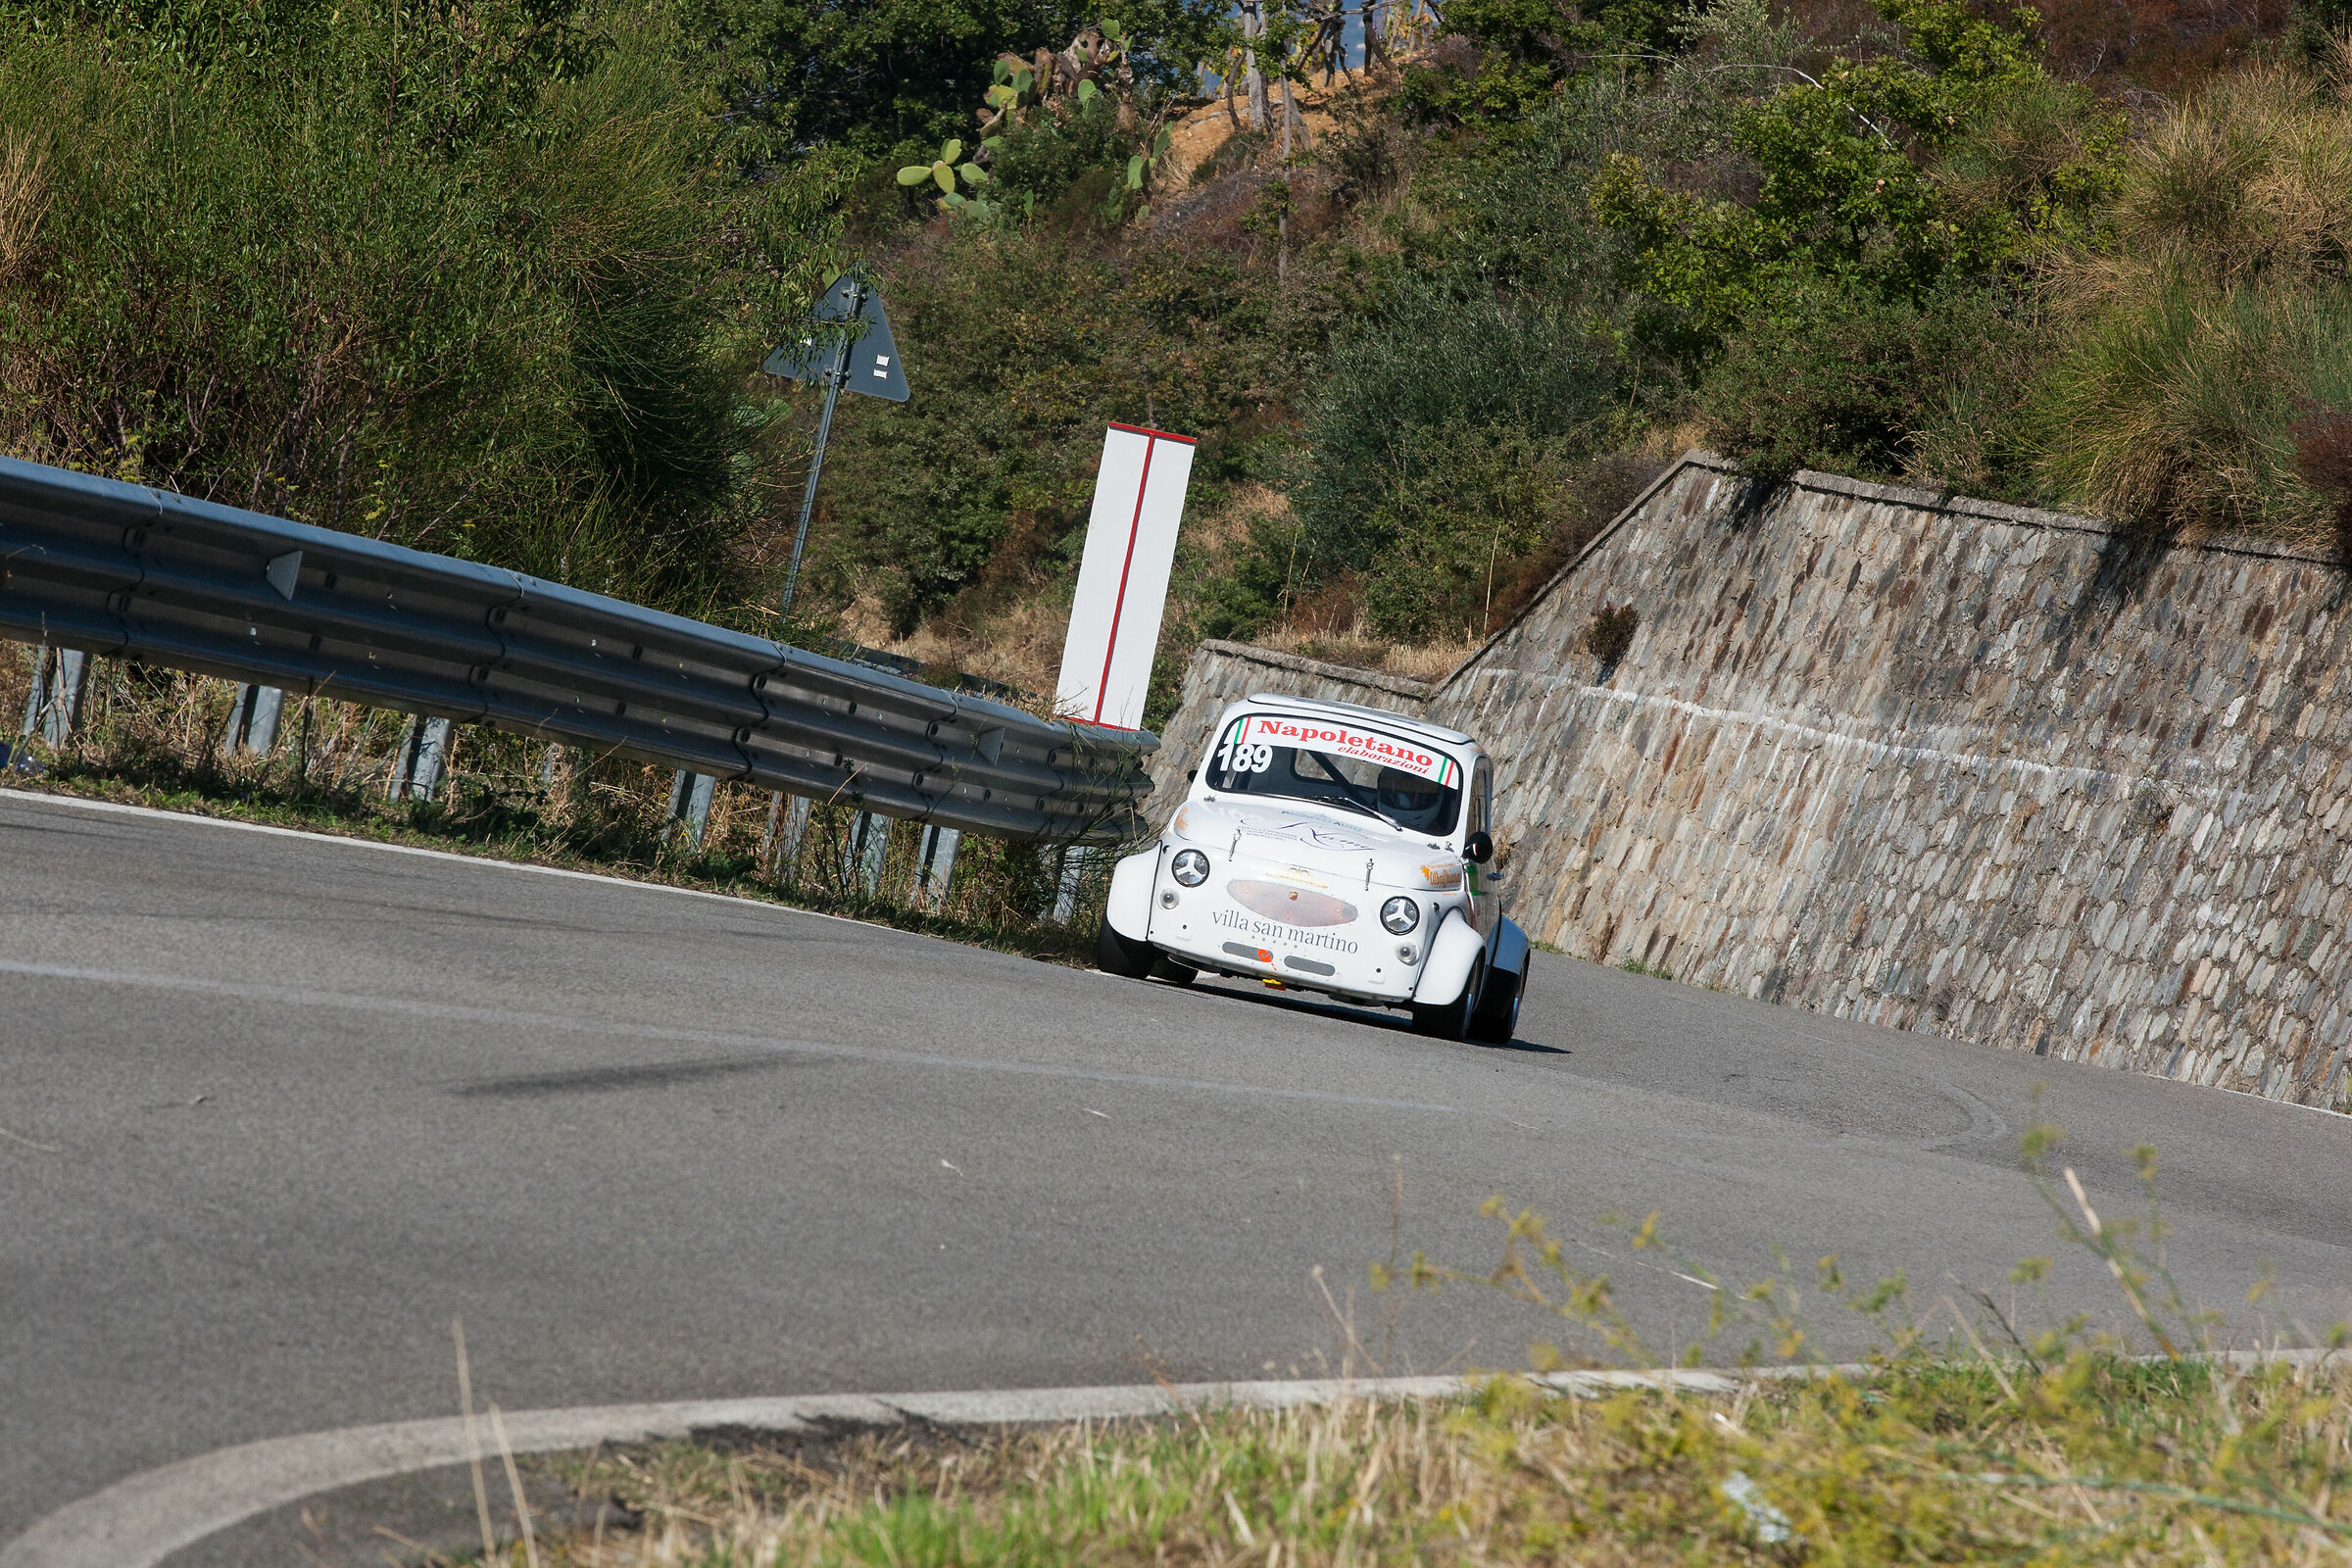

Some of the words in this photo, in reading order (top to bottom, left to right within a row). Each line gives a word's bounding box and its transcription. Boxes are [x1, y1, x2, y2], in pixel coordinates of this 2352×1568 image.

[1217, 743, 1273, 773] 189
[1257, 720, 1433, 766] Napoletano
[1337, 746, 1430, 774] elaborazioni
[1212, 909, 1249, 931] villa
[1252, 917, 1283, 938] san
[1288, 927, 1358, 954] martino
